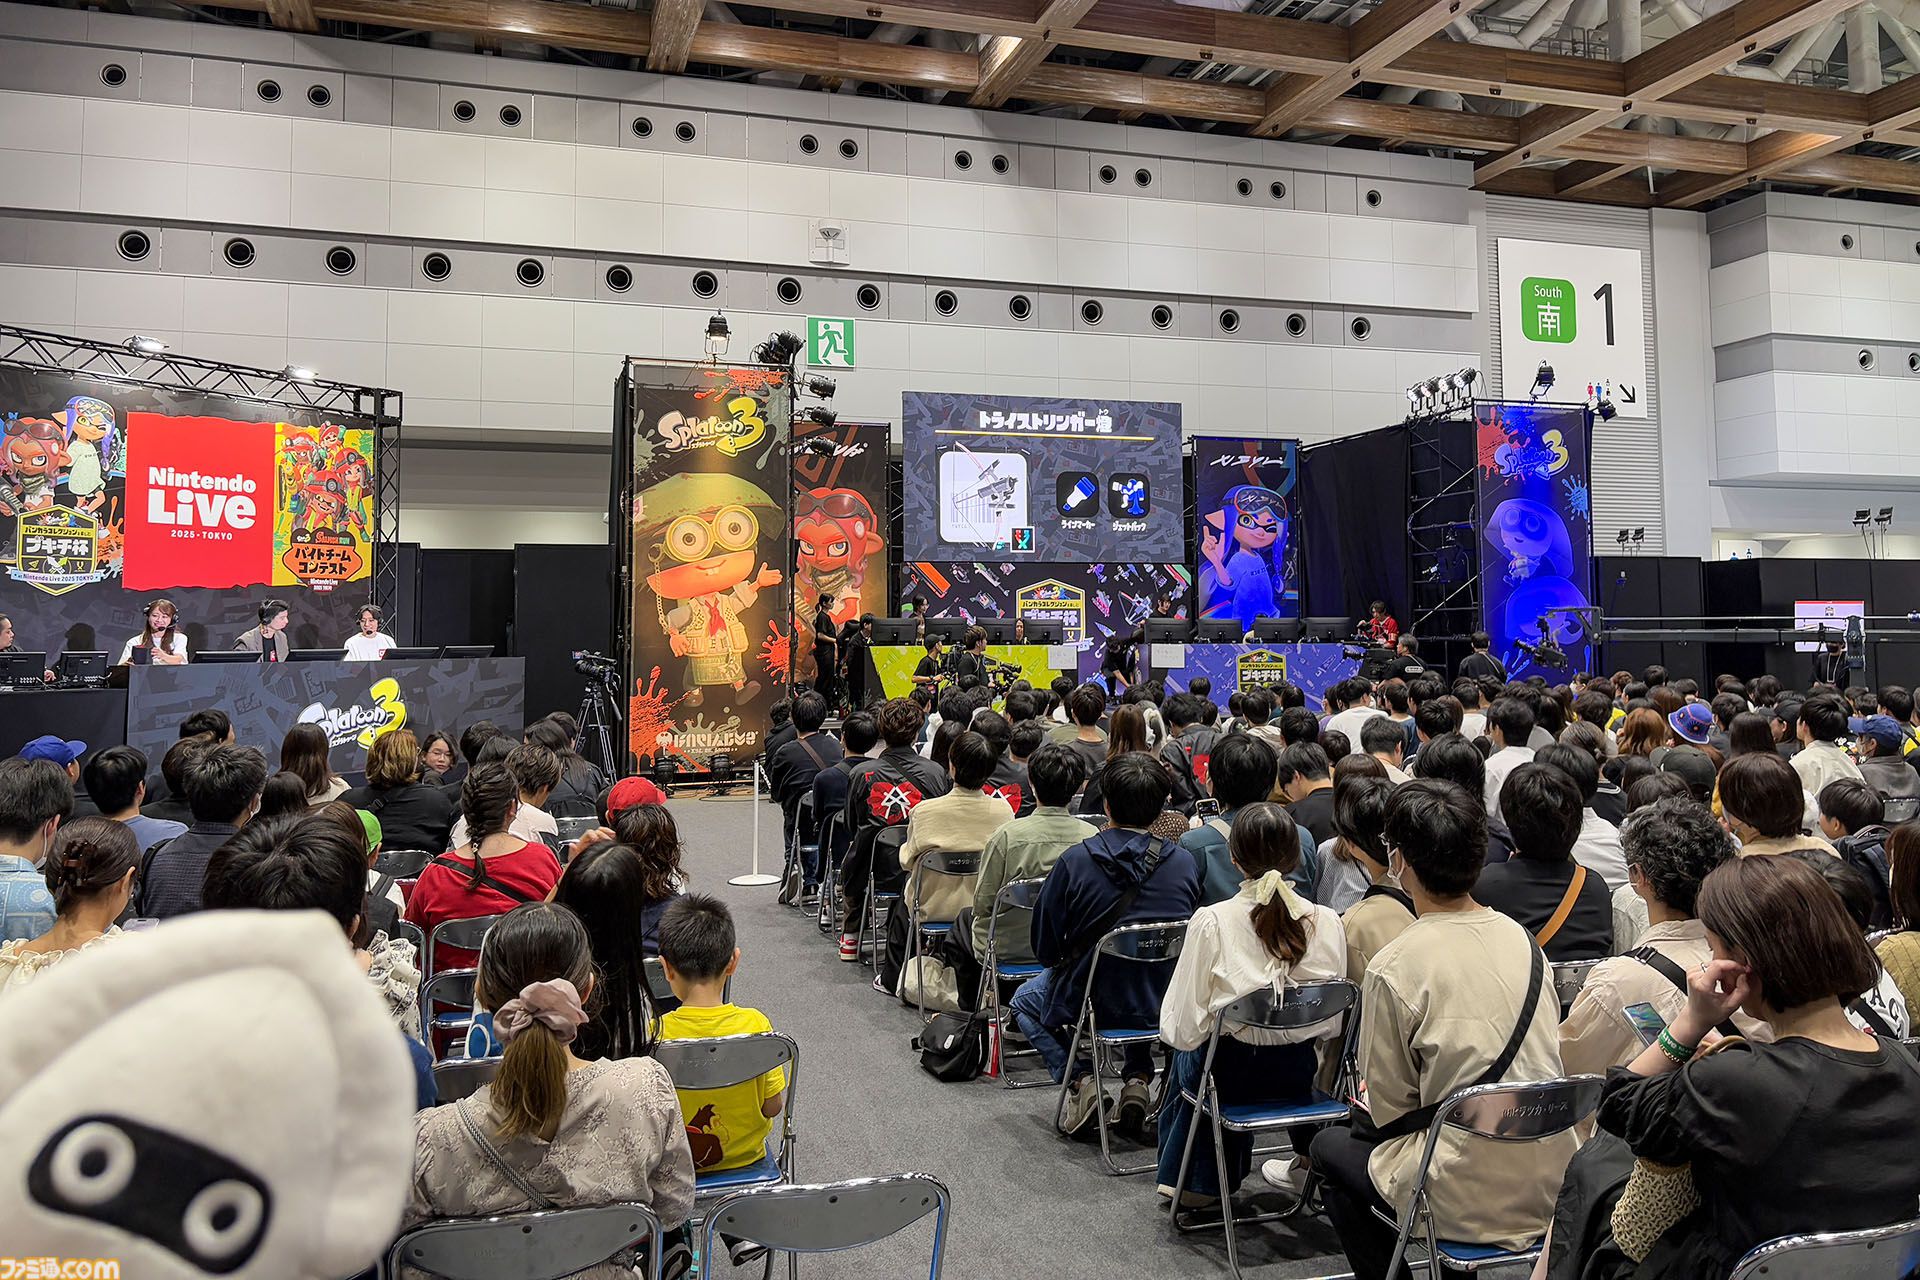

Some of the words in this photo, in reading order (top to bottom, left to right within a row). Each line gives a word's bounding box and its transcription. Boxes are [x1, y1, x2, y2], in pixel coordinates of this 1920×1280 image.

[1534, 285, 1562, 298] South
[1537, 301, 1560, 336] 南
[1593, 284, 1614, 345] 1
[658, 410, 744, 450] Splatoon
[718, 397, 766, 455] 3
[149, 466, 256, 493] Nintendo
[148, 488, 257, 529] Live
[1061, 520, 1095, 529] ラインマーカー
[1112, 521, 1146, 531] ジェットパック
[171, 530, 195, 538] 2025
[202, 531, 233, 540] TOKYO
[26, 536, 89, 555] ブキチ杯
[295, 547, 352, 562] バイトチーム
[299, 562, 347, 575] コンテスト
[23, 573, 48, 581] Nintendo
[1242, 669, 1281, 681] ブキチ杯
[359, 677, 406, 746] 3
